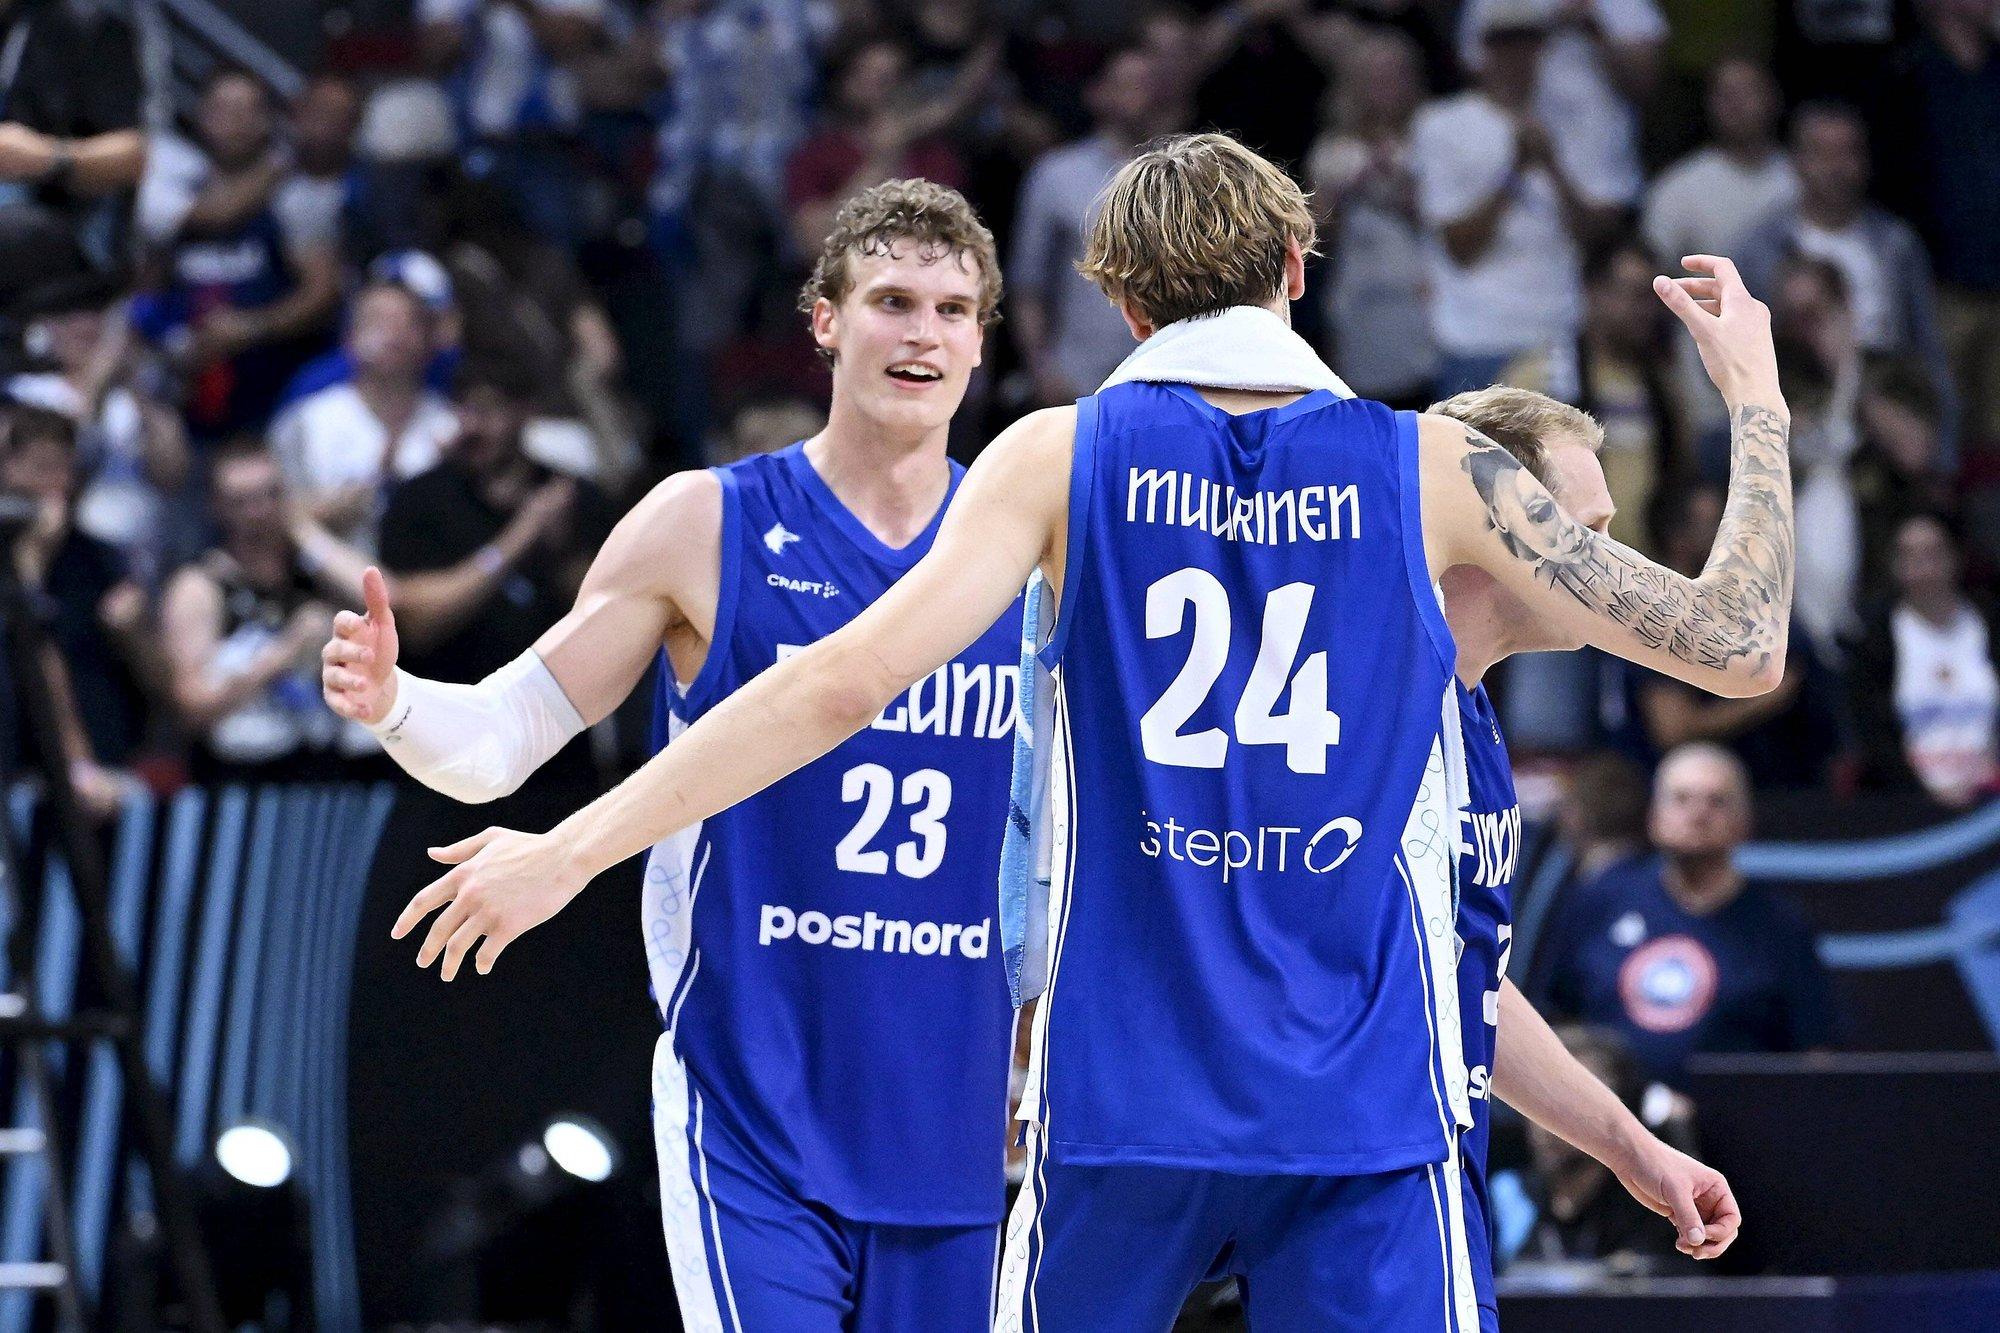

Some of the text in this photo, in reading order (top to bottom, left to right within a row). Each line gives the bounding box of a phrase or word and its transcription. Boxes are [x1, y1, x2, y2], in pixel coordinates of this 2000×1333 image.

[1126, 467, 1361, 546] MUURINEN
[766, 573, 824, 595] CRAFT
[1139, 567, 1341, 775] 24
[835, 762, 952, 879] 23
[758, 904, 991, 959] postnord
